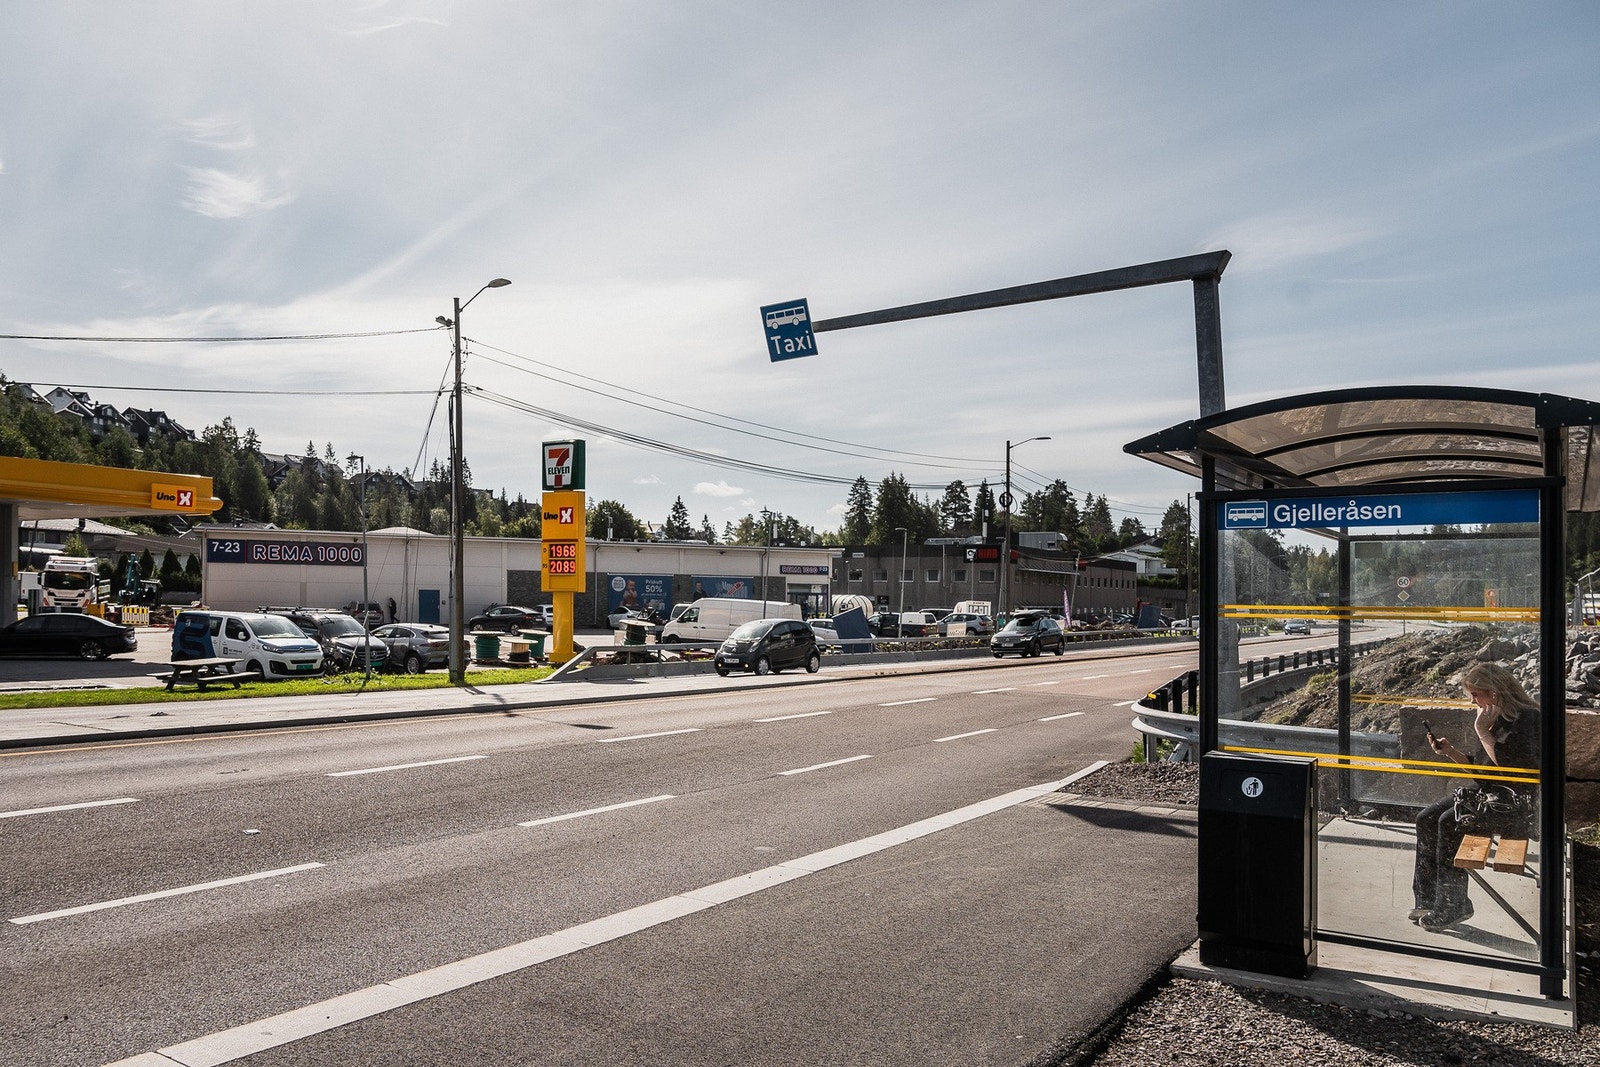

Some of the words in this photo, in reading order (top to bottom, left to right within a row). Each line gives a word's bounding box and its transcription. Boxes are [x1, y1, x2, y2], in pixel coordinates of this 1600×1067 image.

[770, 330, 812, 355] Taxi
[548, 447, 570, 487] 7
[156, 492, 176, 501] Uno
[178, 491, 192, 506] X
[543, 511, 559, 520] Uno
[560, 508, 572, 523] X
[1273, 500, 1402, 527] Gjelleråsen
[211, 541, 240, 553] 7-23
[253, 544, 313, 562] REMA
[317, 546, 362, 563] 1000
[645, 585, 663, 593] 50%
[1398, 578, 1409, 586] 60
